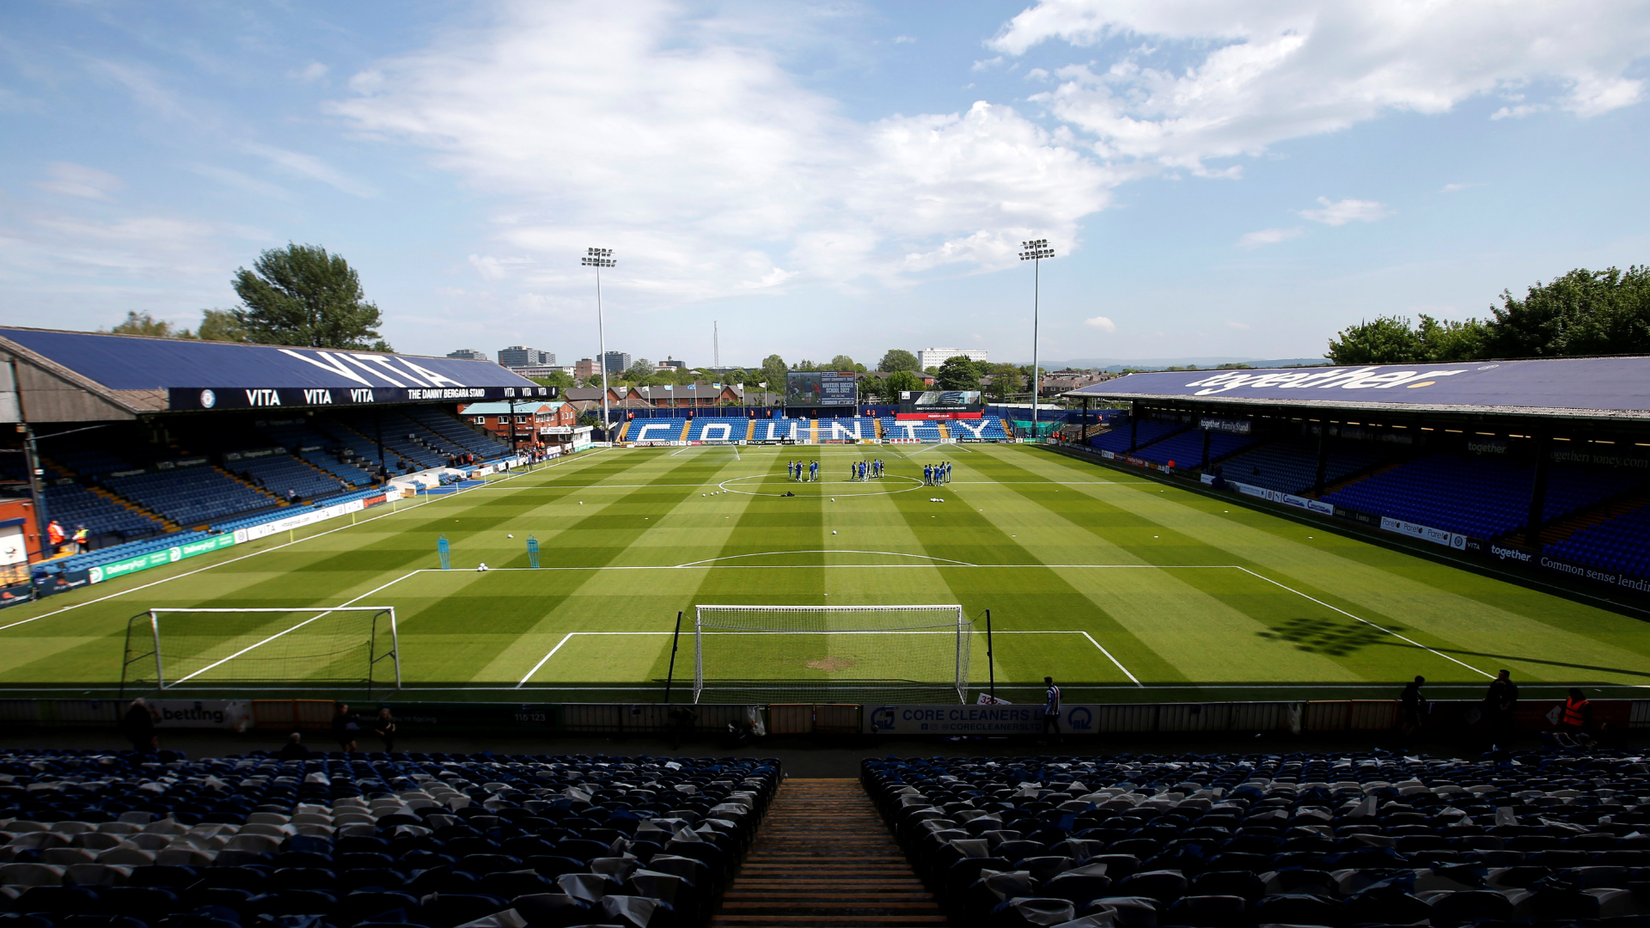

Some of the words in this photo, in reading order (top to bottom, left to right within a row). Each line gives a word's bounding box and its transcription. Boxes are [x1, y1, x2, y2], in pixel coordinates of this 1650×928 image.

[278, 349, 467, 388] VITA
[245, 389, 281, 406] VITA
[303, 389, 333, 405] VITA
[350, 389, 374, 403] VITA
[407, 389, 421, 400] THE
[421, 389, 444, 400] DANNY
[443, 388, 469, 399] BERGARA
[469, 388, 485, 398] STAND
[503, 387, 515, 397] VITA
[521, 387, 531, 397] VITA
[537, 387, 547, 396] VITA
[1467, 541, 1481, 551] VITA
[1540, 556, 1584, 577] Common
[1586, 567, 1616, 584] sense
[163, 707, 224, 723] betting
[413, 715, 438, 724] facing
[530, 713, 546, 722] 123
[903, 709, 945, 721] CORE
[949, 709, 1029, 721] CLEANERS
[942, 723, 1042, 731] @CORECLEANERSLTD
